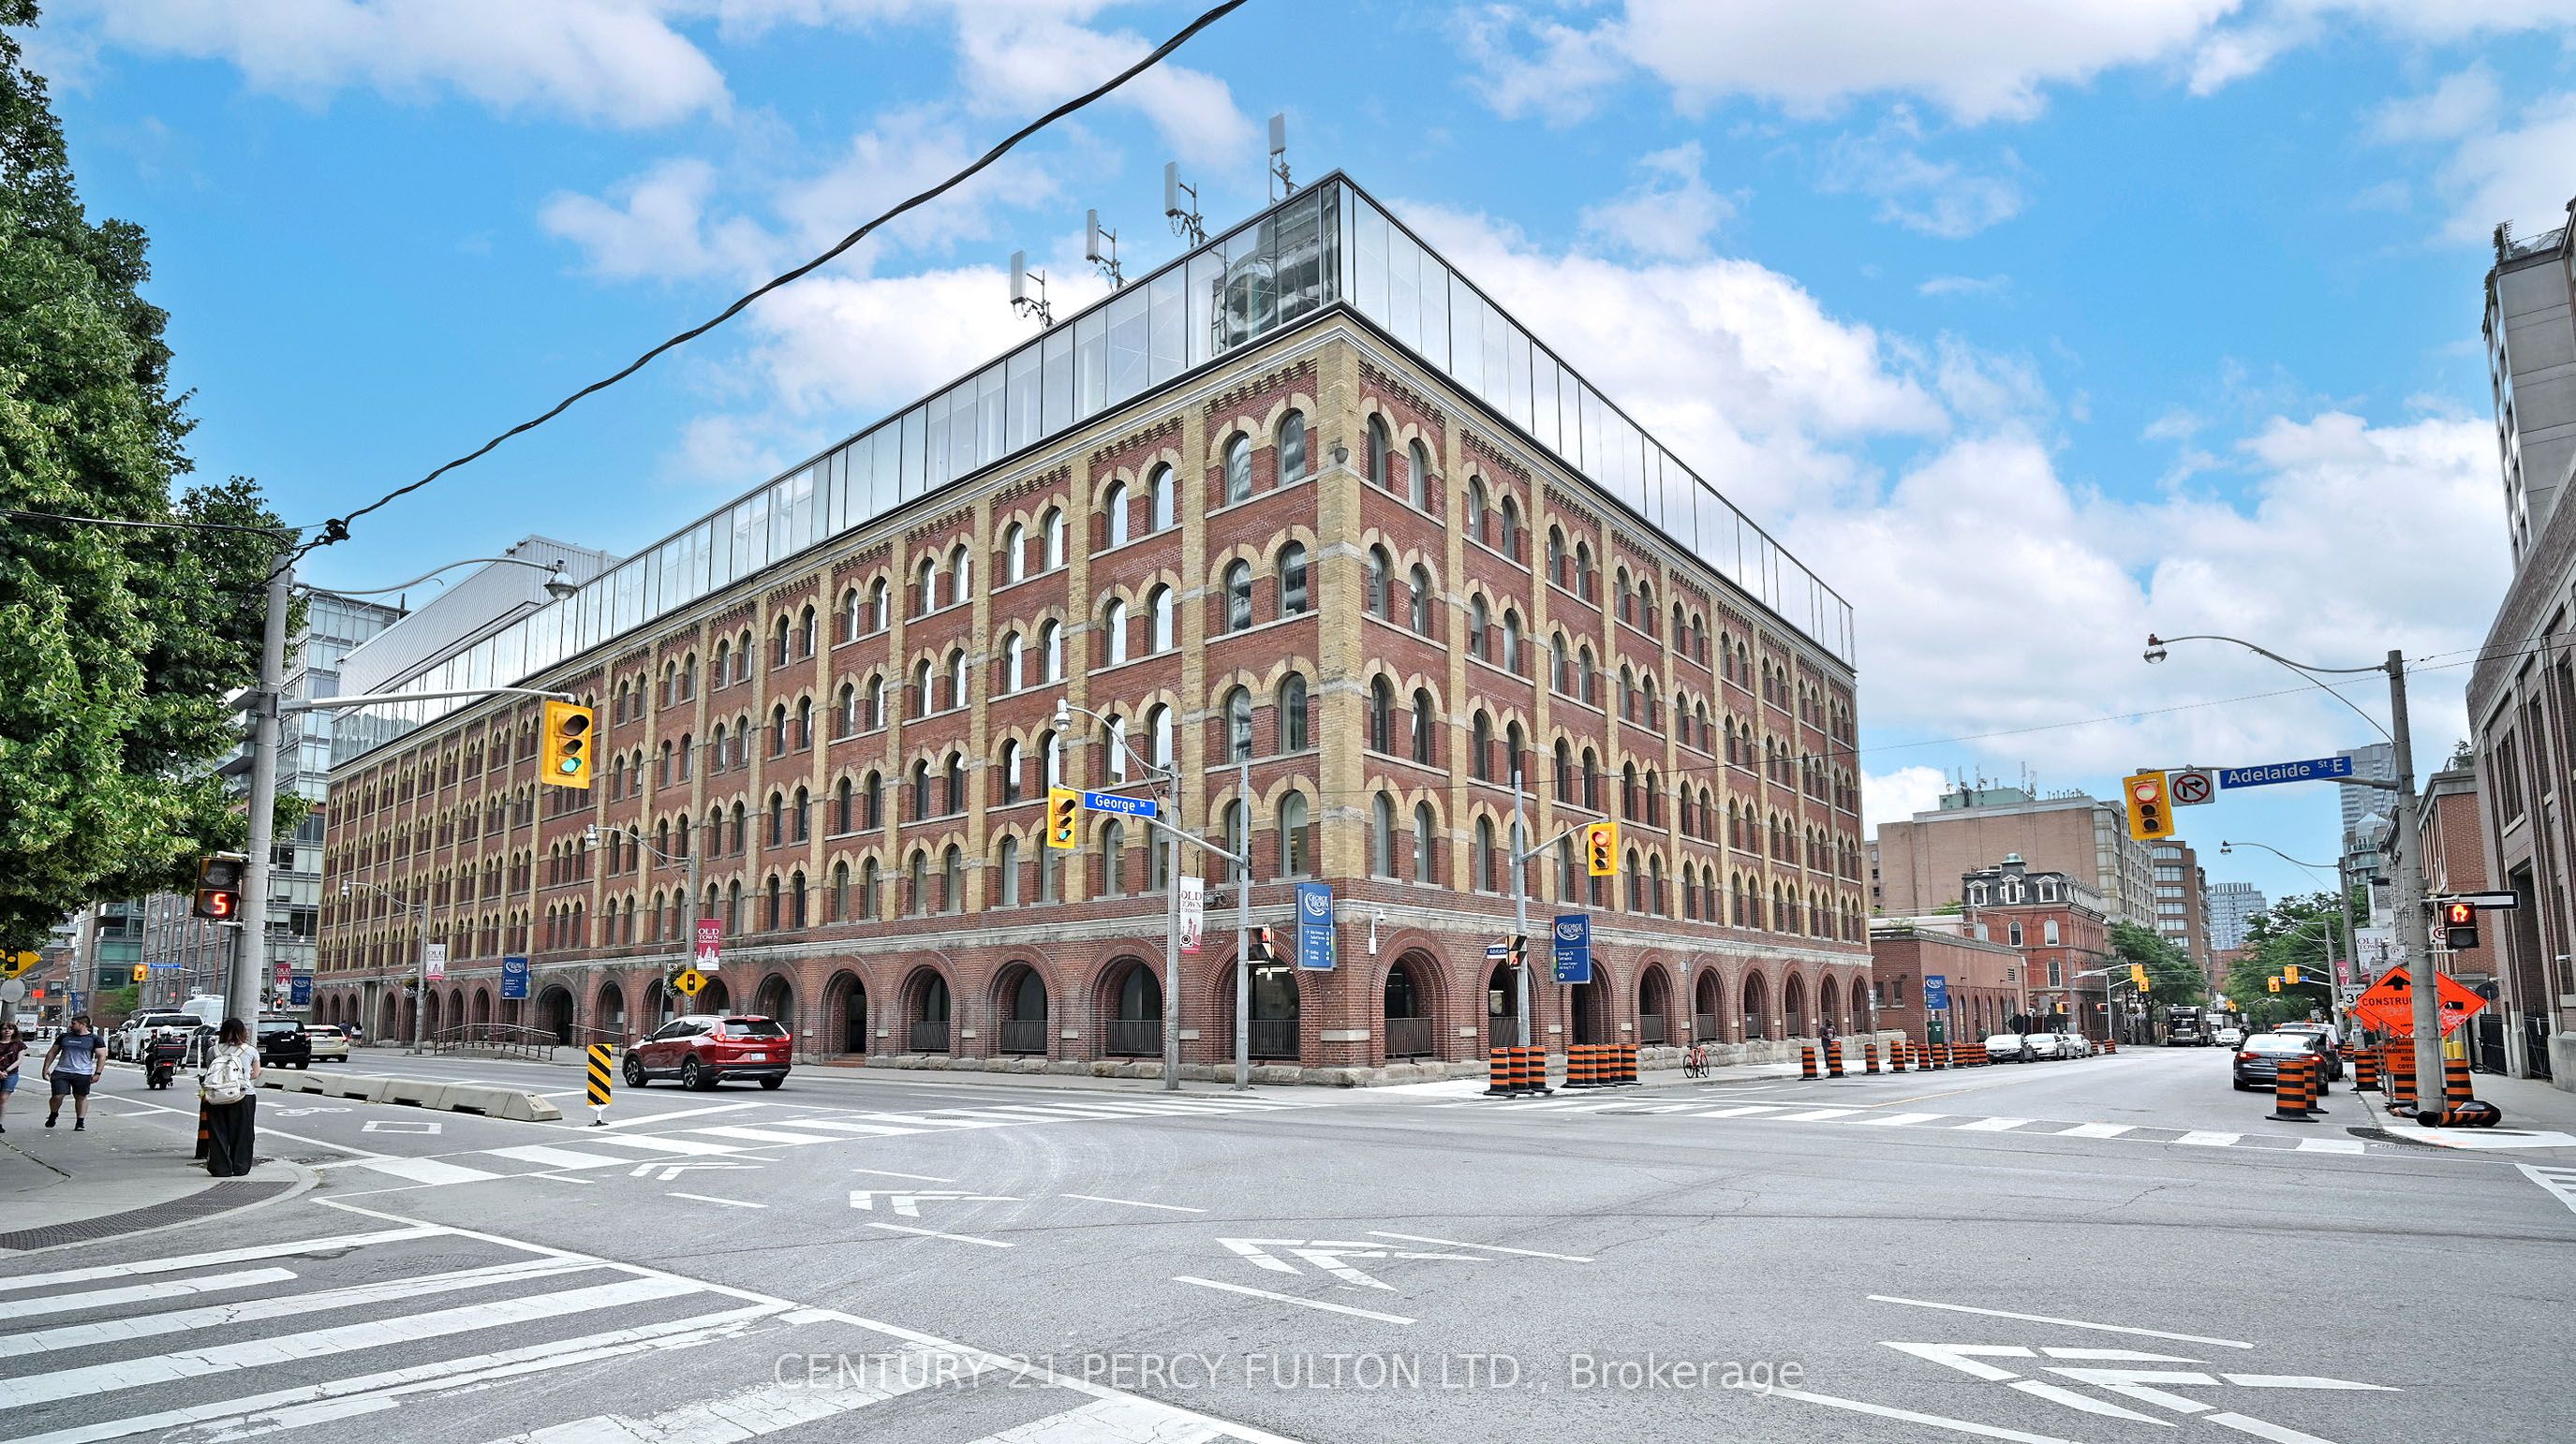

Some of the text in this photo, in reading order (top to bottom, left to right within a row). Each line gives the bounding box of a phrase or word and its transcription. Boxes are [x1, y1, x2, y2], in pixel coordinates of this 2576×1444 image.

[2228, 763, 2310, 785] Adelaide
[1095, 795, 1136, 813] George
[1181, 891, 1203, 901] OLD
[214, 893, 227, 915] 5
[1182, 900, 1202, 908] TOWN
[2361, 996, 2413, 1007] CONSTRU
